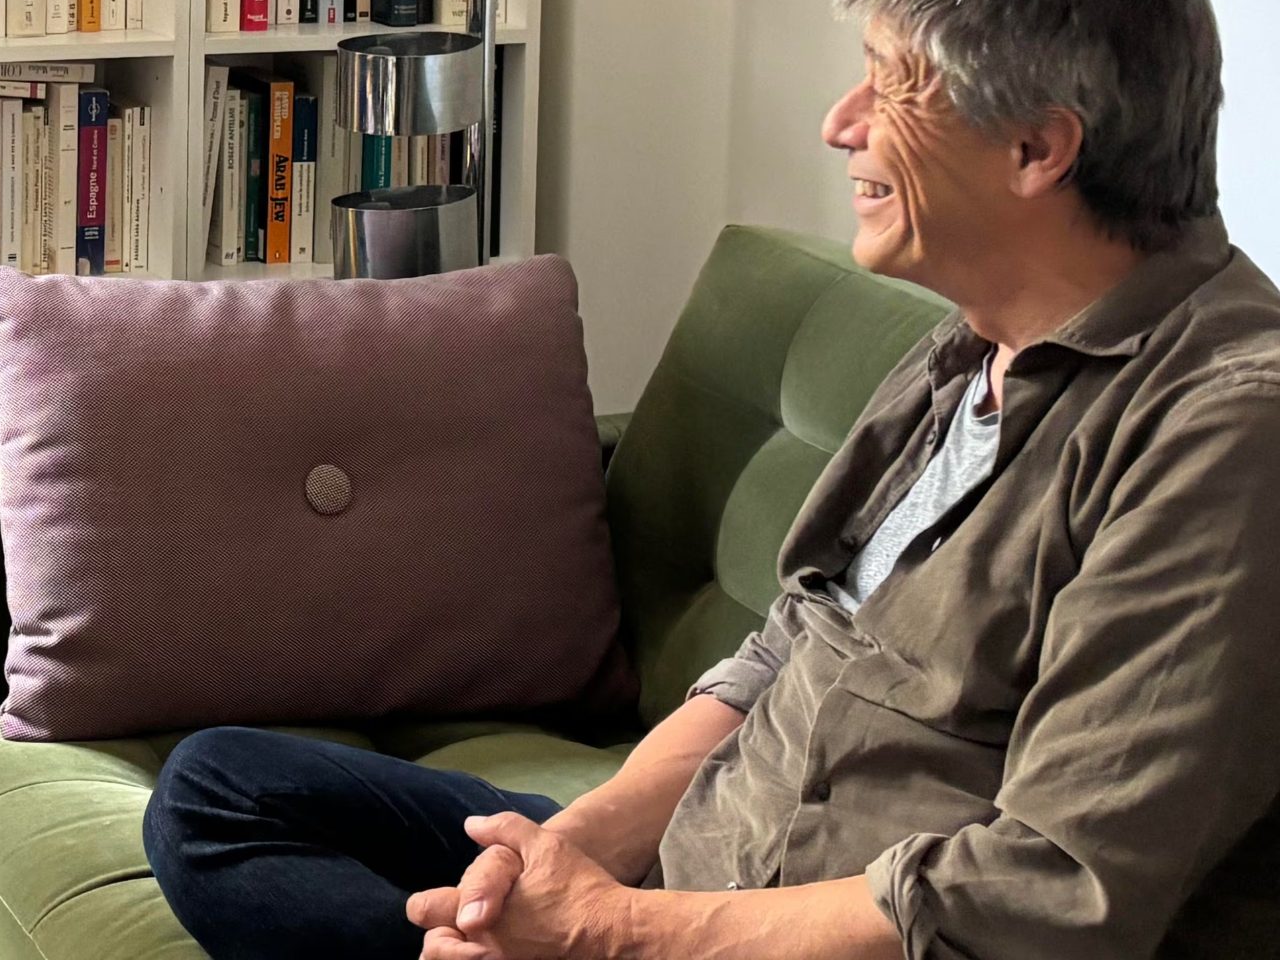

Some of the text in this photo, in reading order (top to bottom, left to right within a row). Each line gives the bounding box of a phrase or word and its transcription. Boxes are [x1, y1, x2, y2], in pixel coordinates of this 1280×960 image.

[87, 172, 99, 219] Espagne
[270, 154, 289, 223] ARAB JEW
